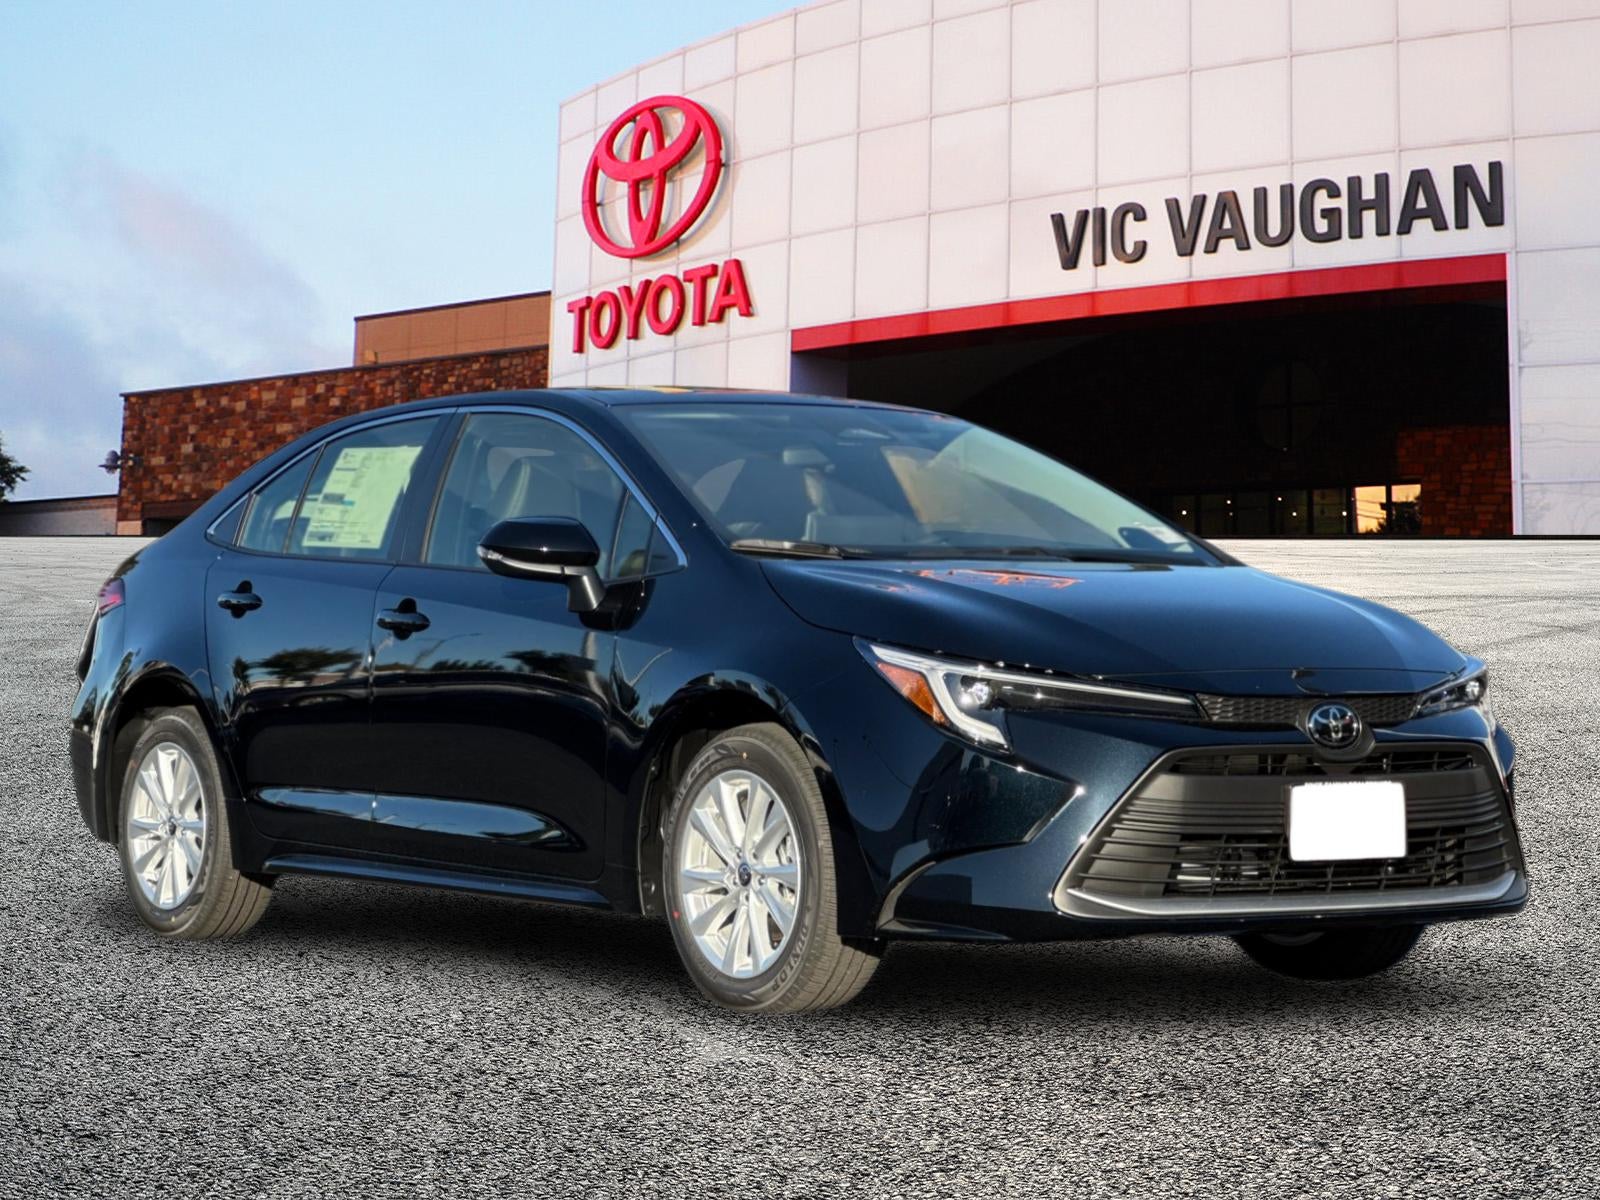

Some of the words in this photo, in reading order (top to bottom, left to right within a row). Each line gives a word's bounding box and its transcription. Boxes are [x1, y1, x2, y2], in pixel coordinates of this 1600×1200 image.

[1051, 202, 1147, 270] VIC
[1165, 160, 1505, 256] VAUGHAN
[567, 259, 753, 353] TOYOTA
[772, 922, 808, 991] DUNLOP
